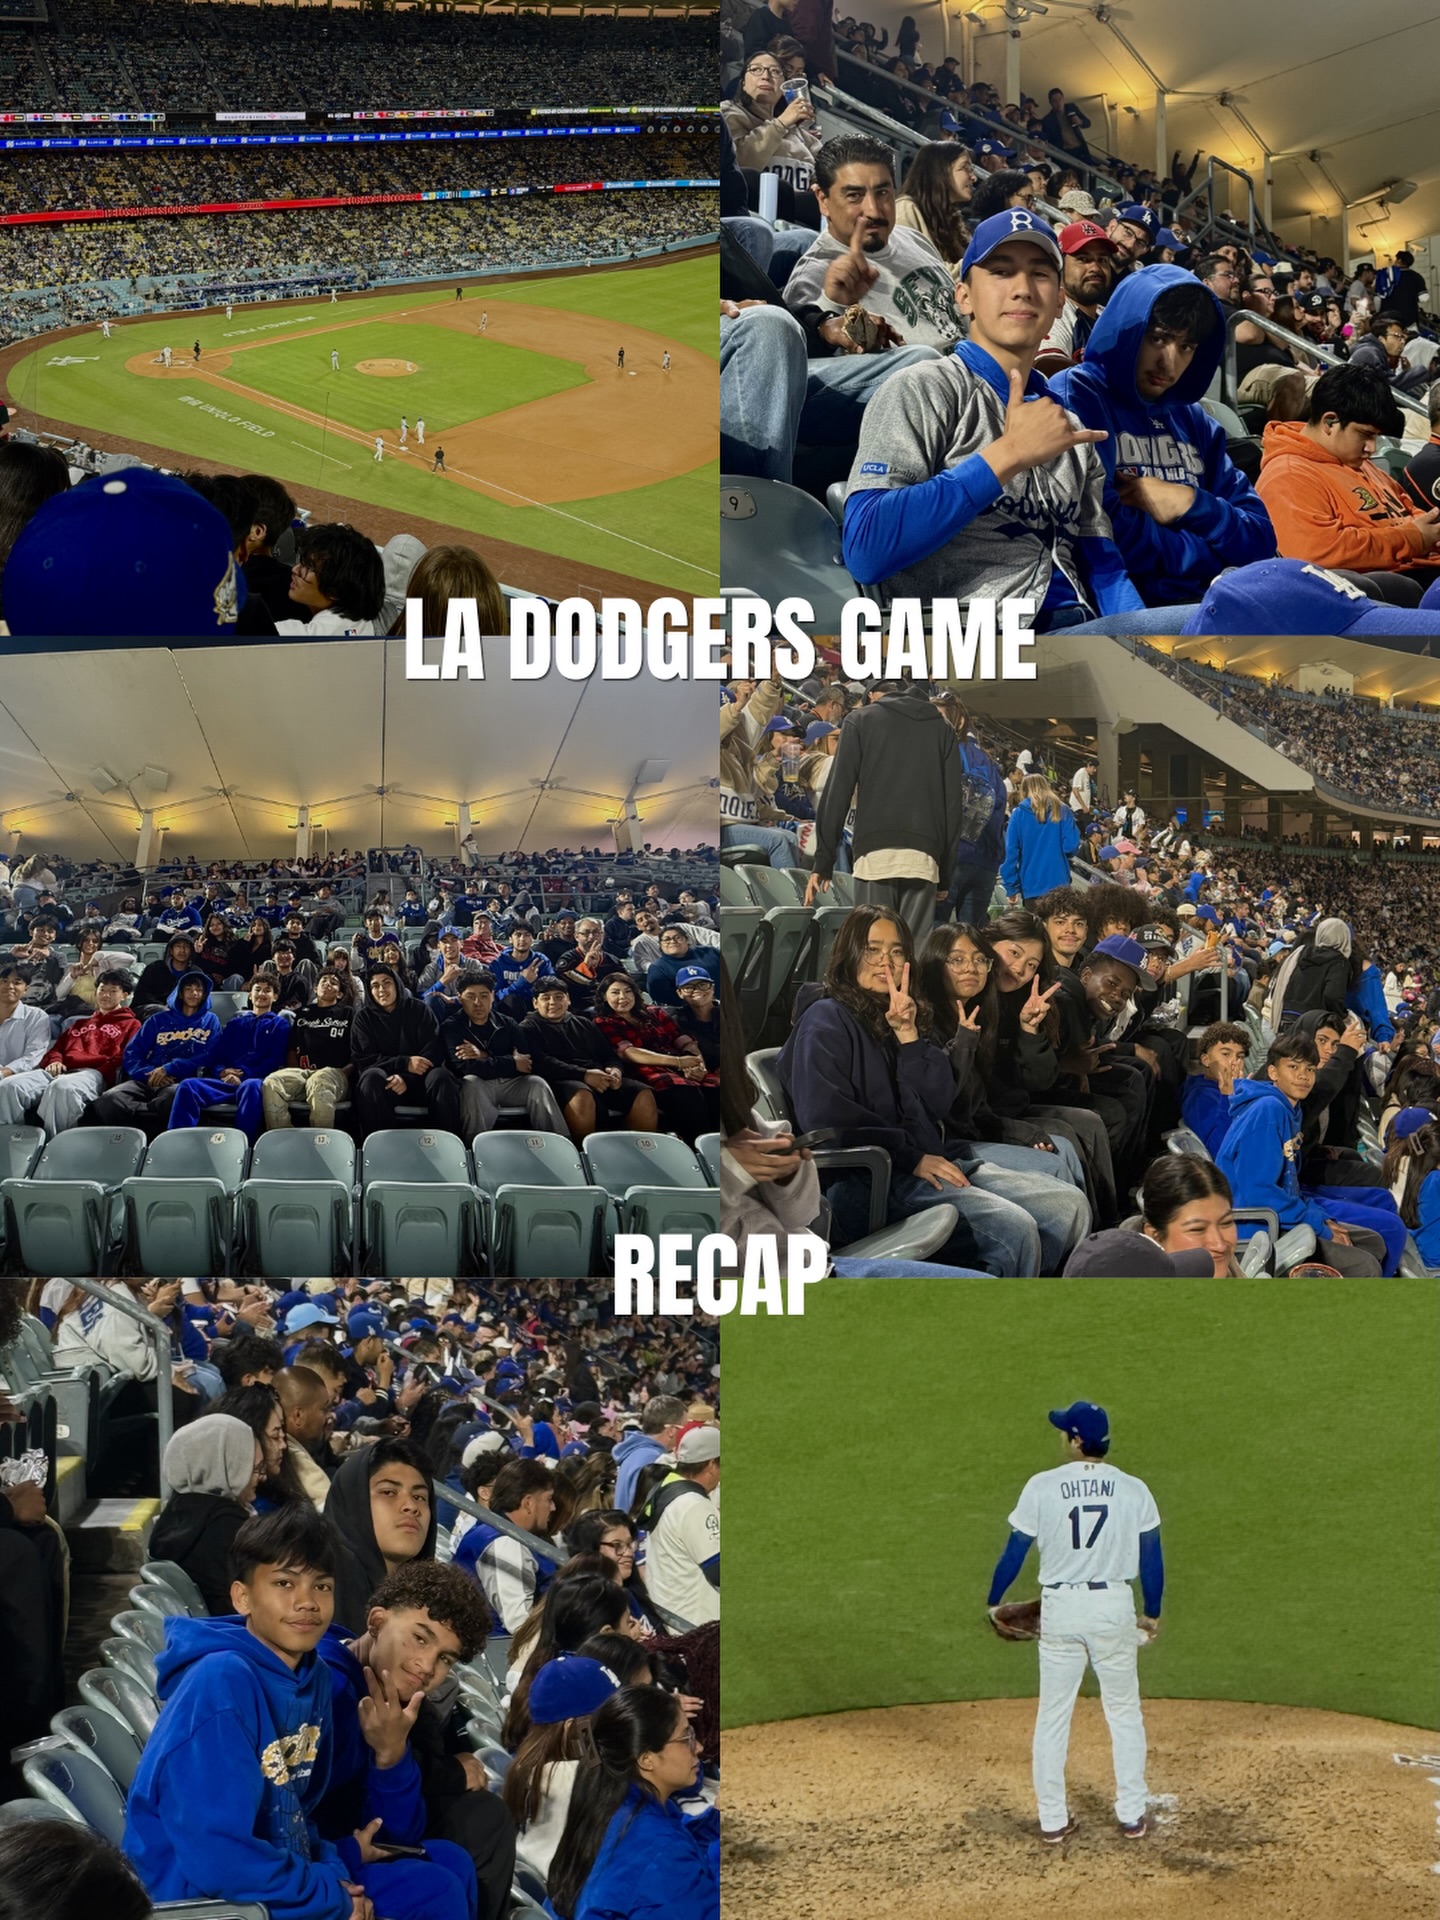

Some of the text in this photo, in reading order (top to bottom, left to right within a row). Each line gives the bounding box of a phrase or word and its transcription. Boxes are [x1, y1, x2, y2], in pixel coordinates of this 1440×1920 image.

[862, 464, 885, 473] UCLA
[729, 496, 739, 511] 9
[330, 1027, 345, 1038] 04
[1060, 1479, 1116, 1500] OHTANI
[1068, 1504, 1109, 1550] 17
